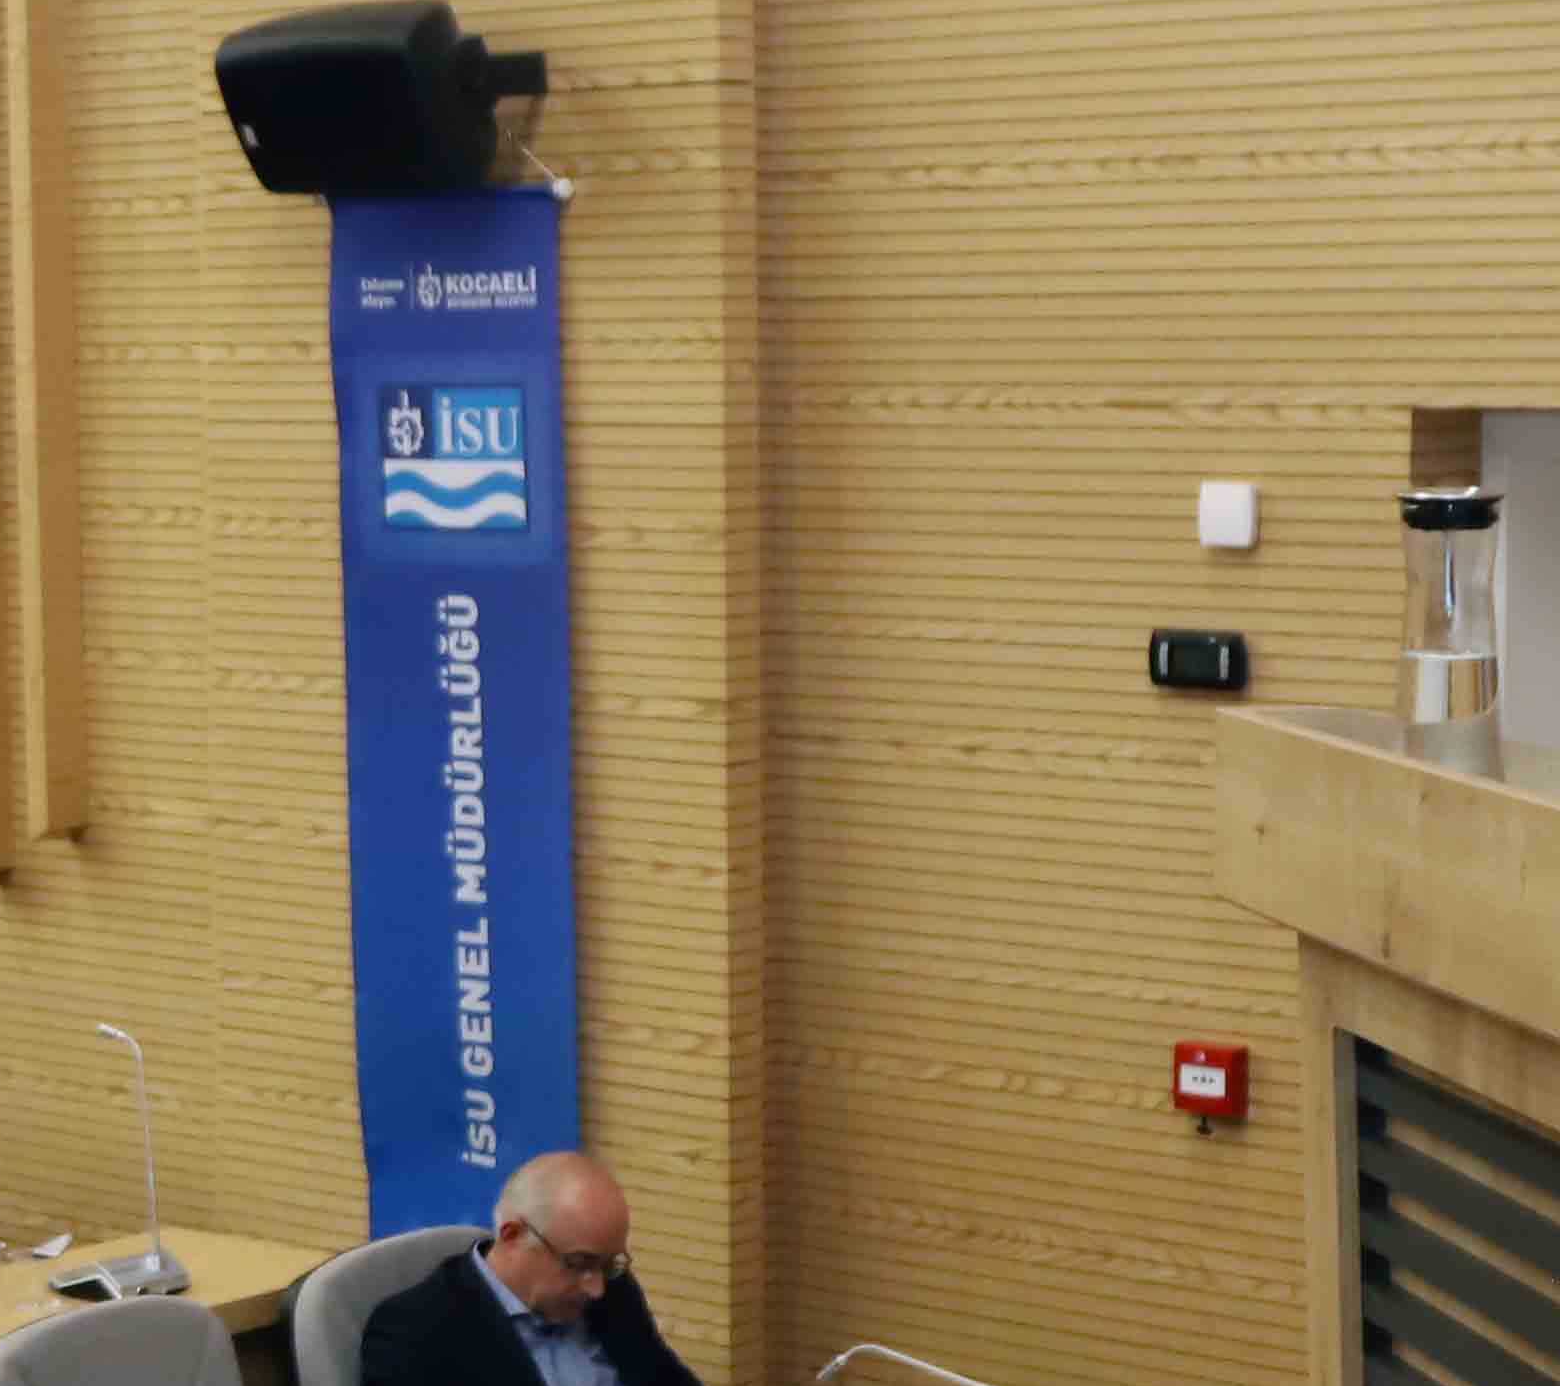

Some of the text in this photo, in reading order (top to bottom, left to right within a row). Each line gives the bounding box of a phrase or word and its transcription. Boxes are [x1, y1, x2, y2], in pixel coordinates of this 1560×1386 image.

[445, 265, 537, 294] KOCAELİ
[440, 396, 520, 455] İSU
[438, 594, 488, 905] MÜDÜRLÜĞÜ
[457, 917, 494, 1078] GENEL
